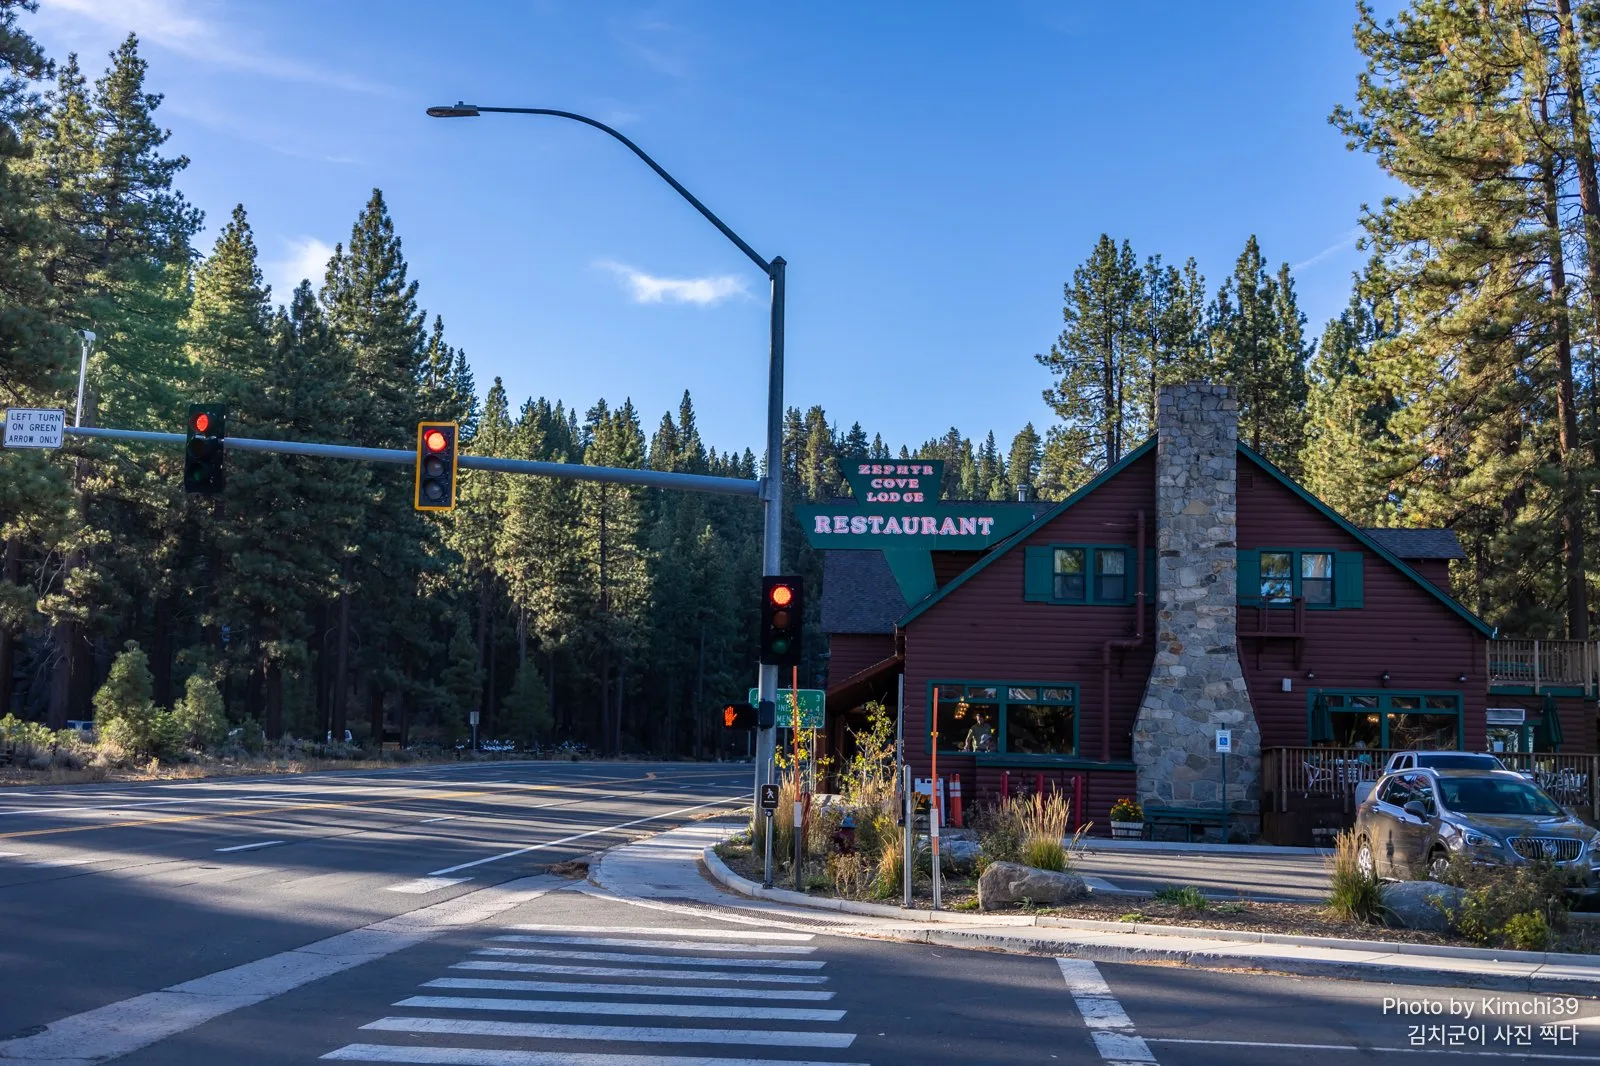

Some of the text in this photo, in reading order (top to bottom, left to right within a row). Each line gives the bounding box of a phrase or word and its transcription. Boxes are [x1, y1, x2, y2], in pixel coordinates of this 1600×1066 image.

[11, 413, 61, 422] LEFT TURN
[12, 423, 57, 432] ON GREEN
[9, 435, 58, 444] ARROW ONLY
[858, 464, 934, 475] ZEPHYR
[870, 478, 919, 489] COVE
[866, 492, 924, 503] LODGE
[814, 515, 995, 536] RESTAURANT
